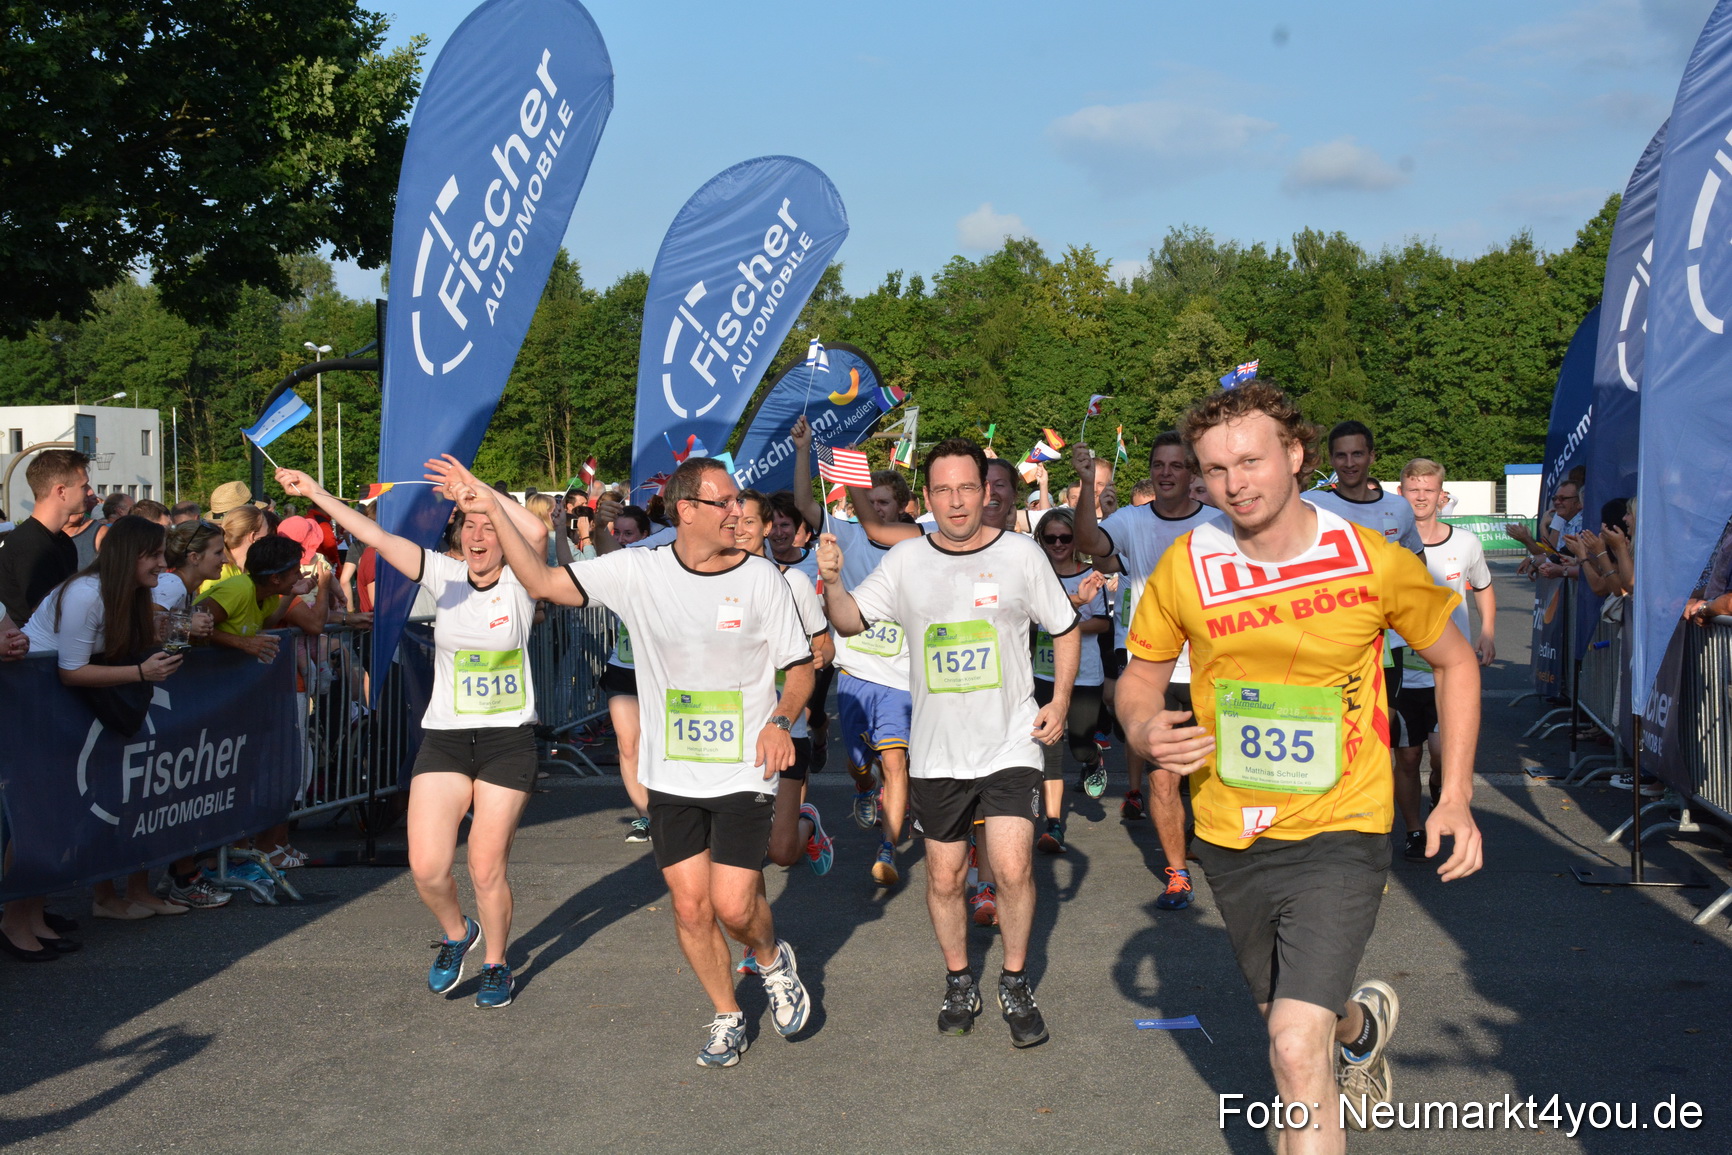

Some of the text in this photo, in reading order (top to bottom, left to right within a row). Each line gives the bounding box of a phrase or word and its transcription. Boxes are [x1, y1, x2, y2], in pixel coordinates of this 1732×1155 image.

[438, 48, 558, 331] Fischer
[486, 100, 575, 326] AUTOMOBILE
[689, 197, 799, 387] Fischer
[731, 231, 813, 384] AUTOMOBILE
[843, 400, 876, 429] Medien
[1206, 585, 1379, 639] MAX BÖGL
[858, 624, 898, 644] 543
[932, 647, 991, 673] 1527
[1038, 648, 1055, 664] 15
[462, 674, 518, 697] 1518
[673, 718, 734, 742] 1538
[1240, 724, 1315, 763] 835
[121, 728, 248, 804] Fischer
[1245, 765, 1308, 779] Matthias Schuller
[132, 787, 236, 838] AUTOMOBILE
